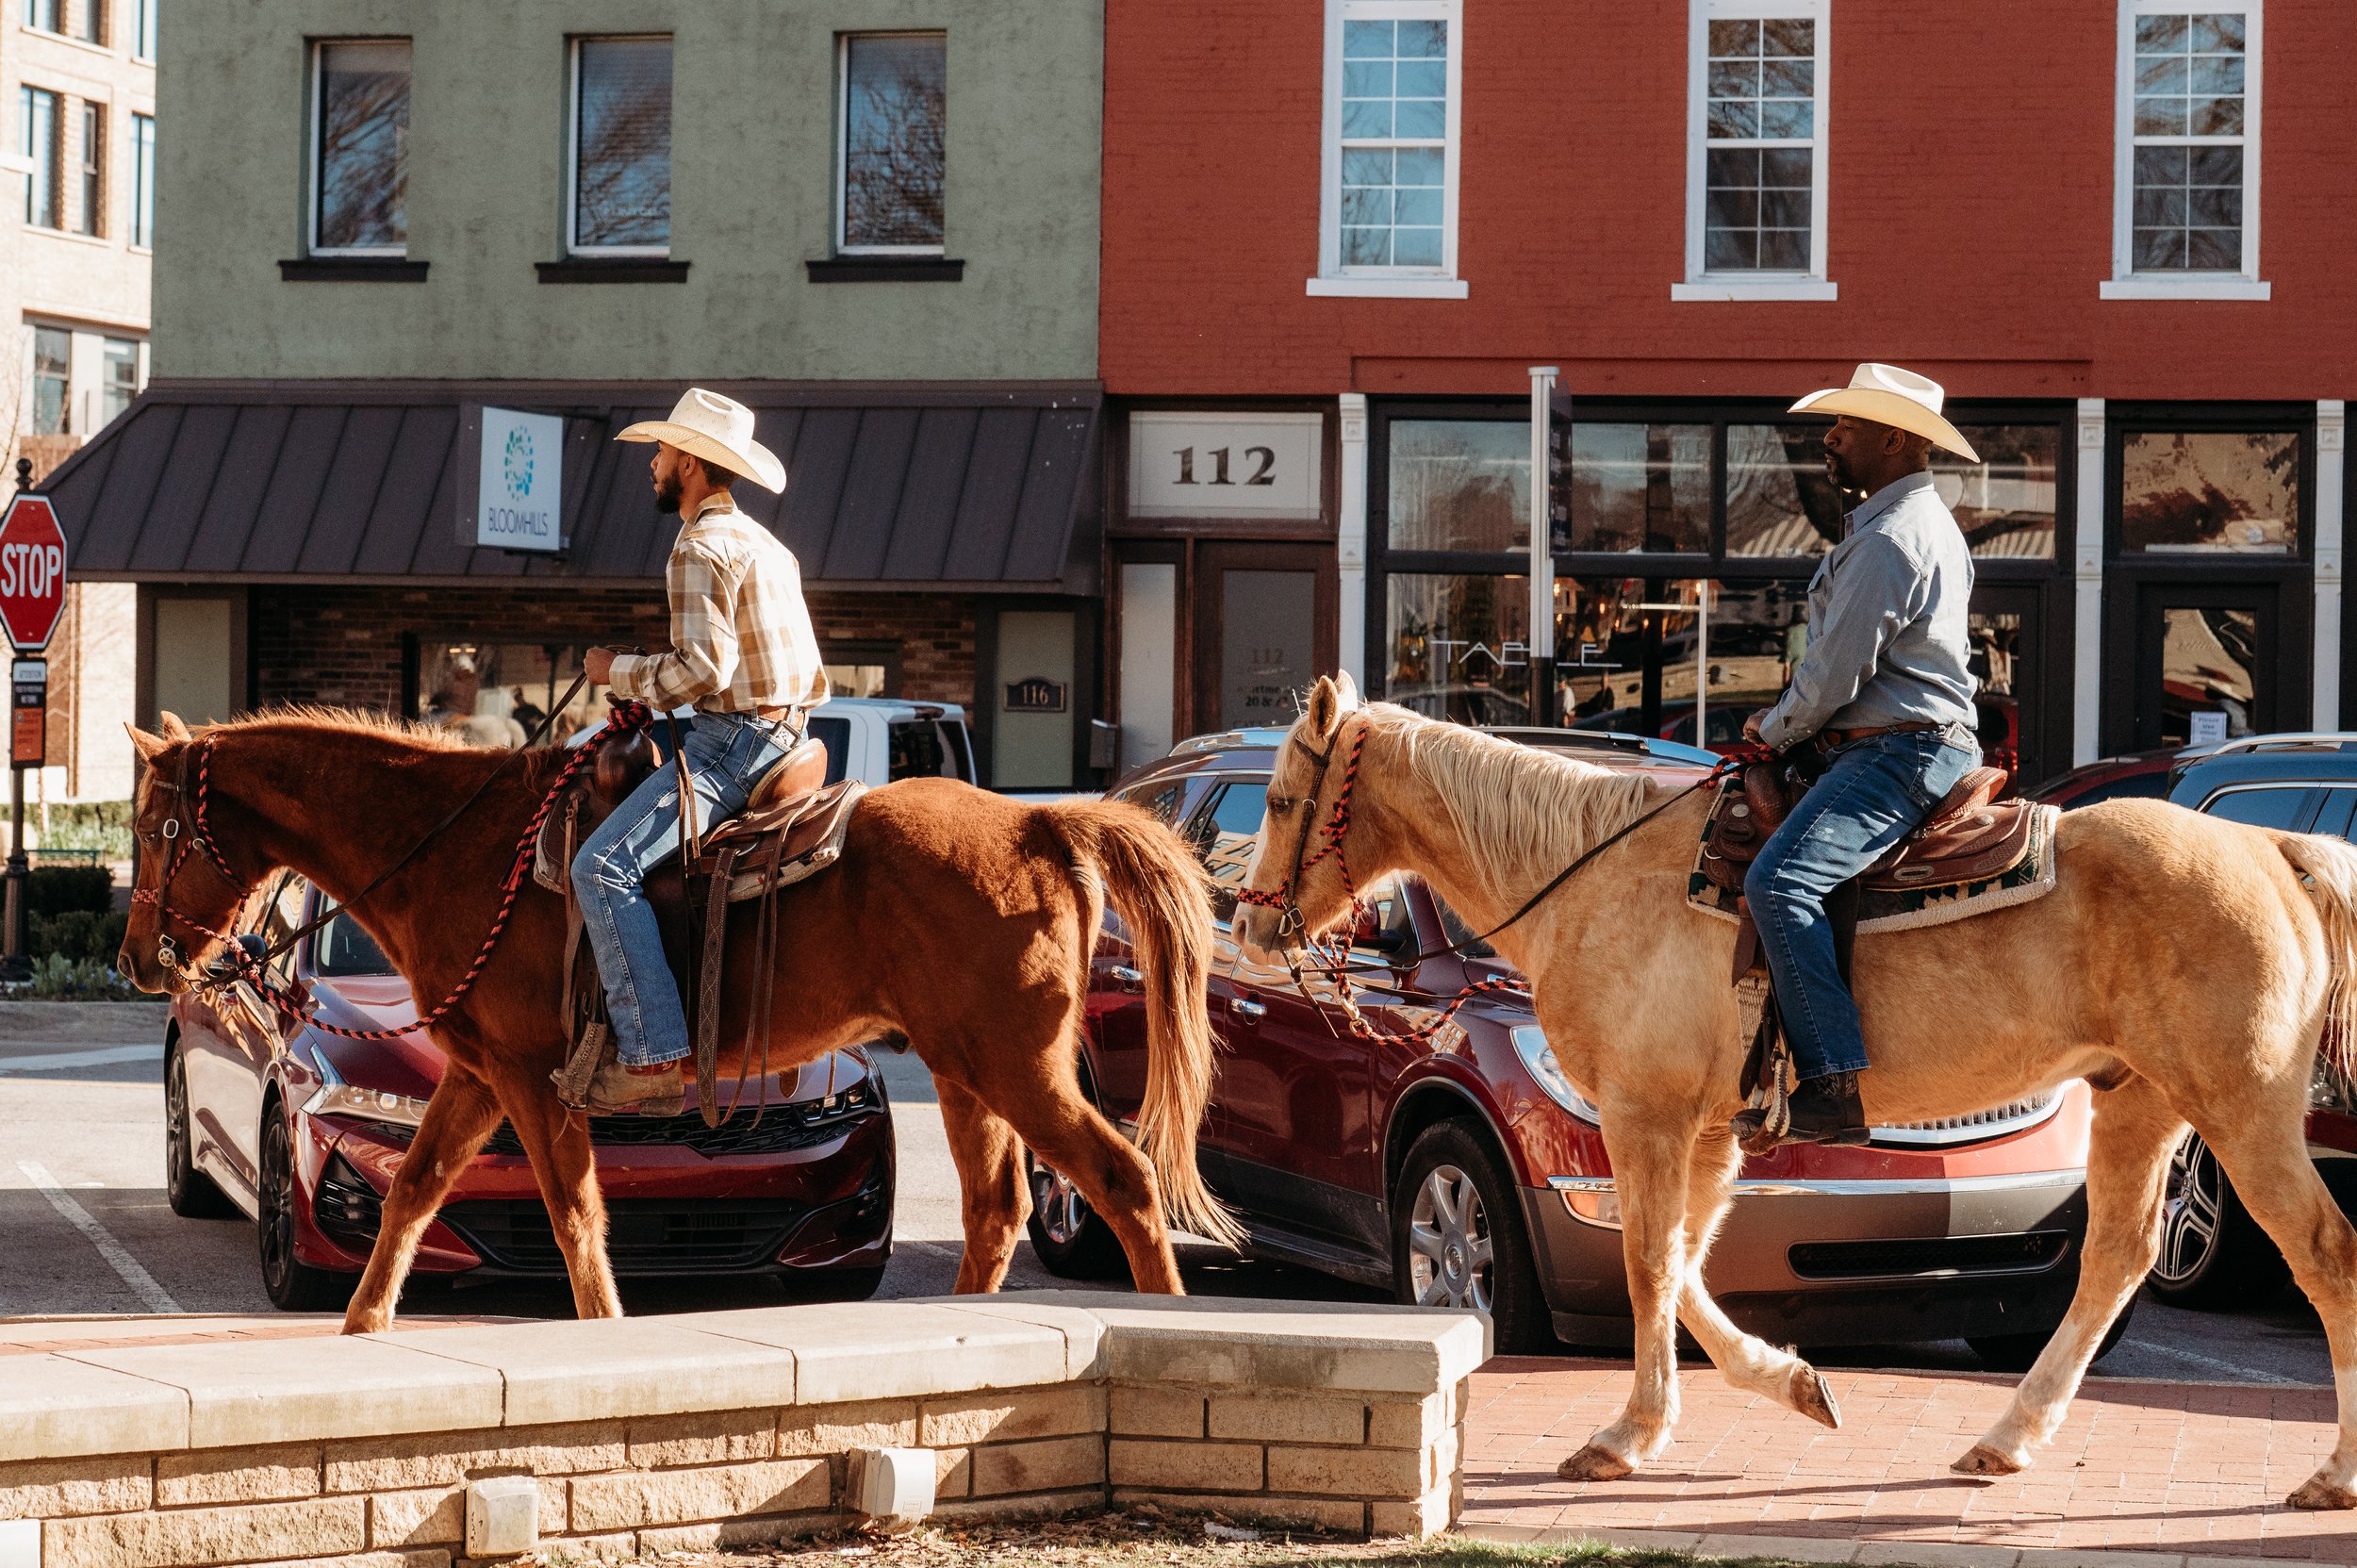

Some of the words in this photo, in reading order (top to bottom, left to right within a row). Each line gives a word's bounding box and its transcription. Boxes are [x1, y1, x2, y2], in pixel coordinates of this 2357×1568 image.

[1172, 445, 1277, 487] 112
[488, 507, 549, 536] BLOOMHILLS
[1, 542, 62, 599] STOP
[1251, 647, 1284, 665] 112
[1023, 685, 1049, 705] 116
[1245, 696, 1260, 707] 20
[1261, 696, 1273, 707] &
